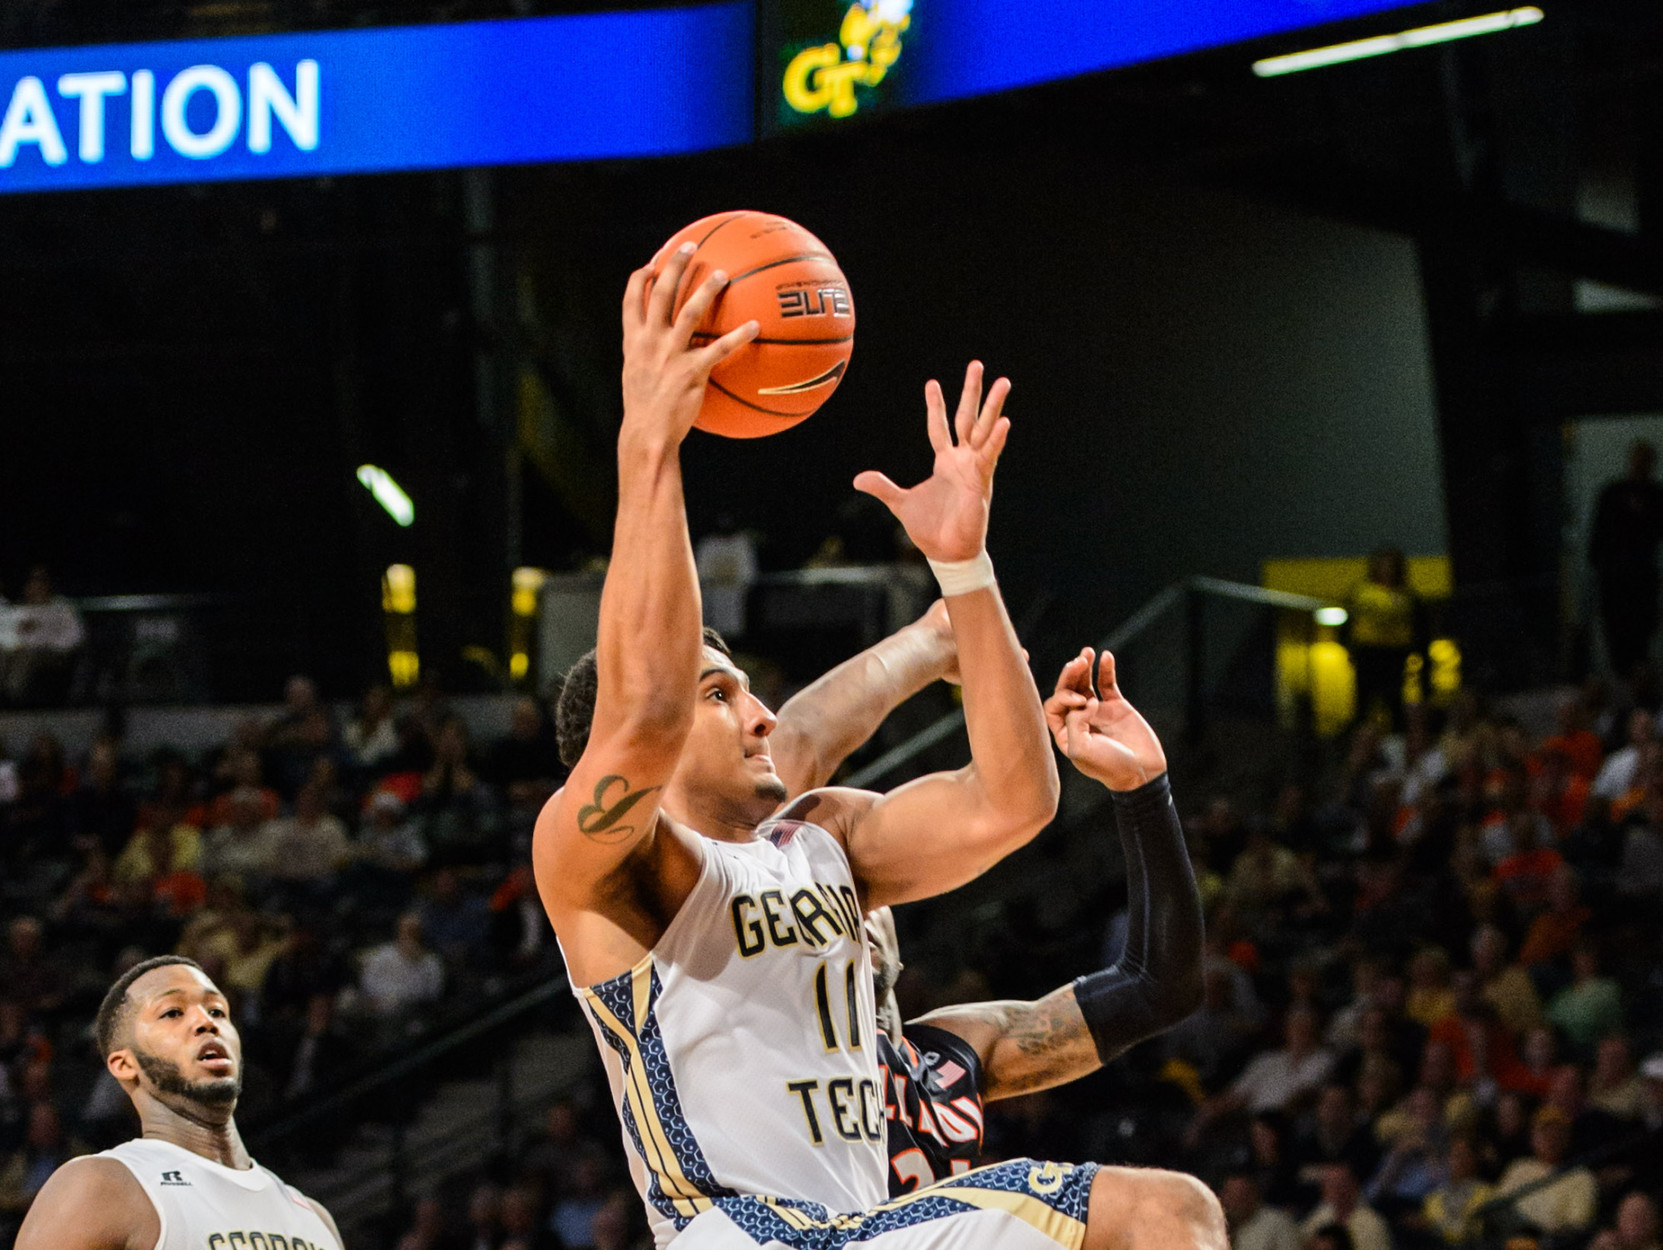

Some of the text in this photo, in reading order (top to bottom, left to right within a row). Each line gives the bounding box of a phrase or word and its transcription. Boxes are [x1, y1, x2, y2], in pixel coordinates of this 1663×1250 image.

[0, 58, 320, 168] ATION
[813, 958, 862, 1052] 11
[786, 1076, 887, 1147] TEC
